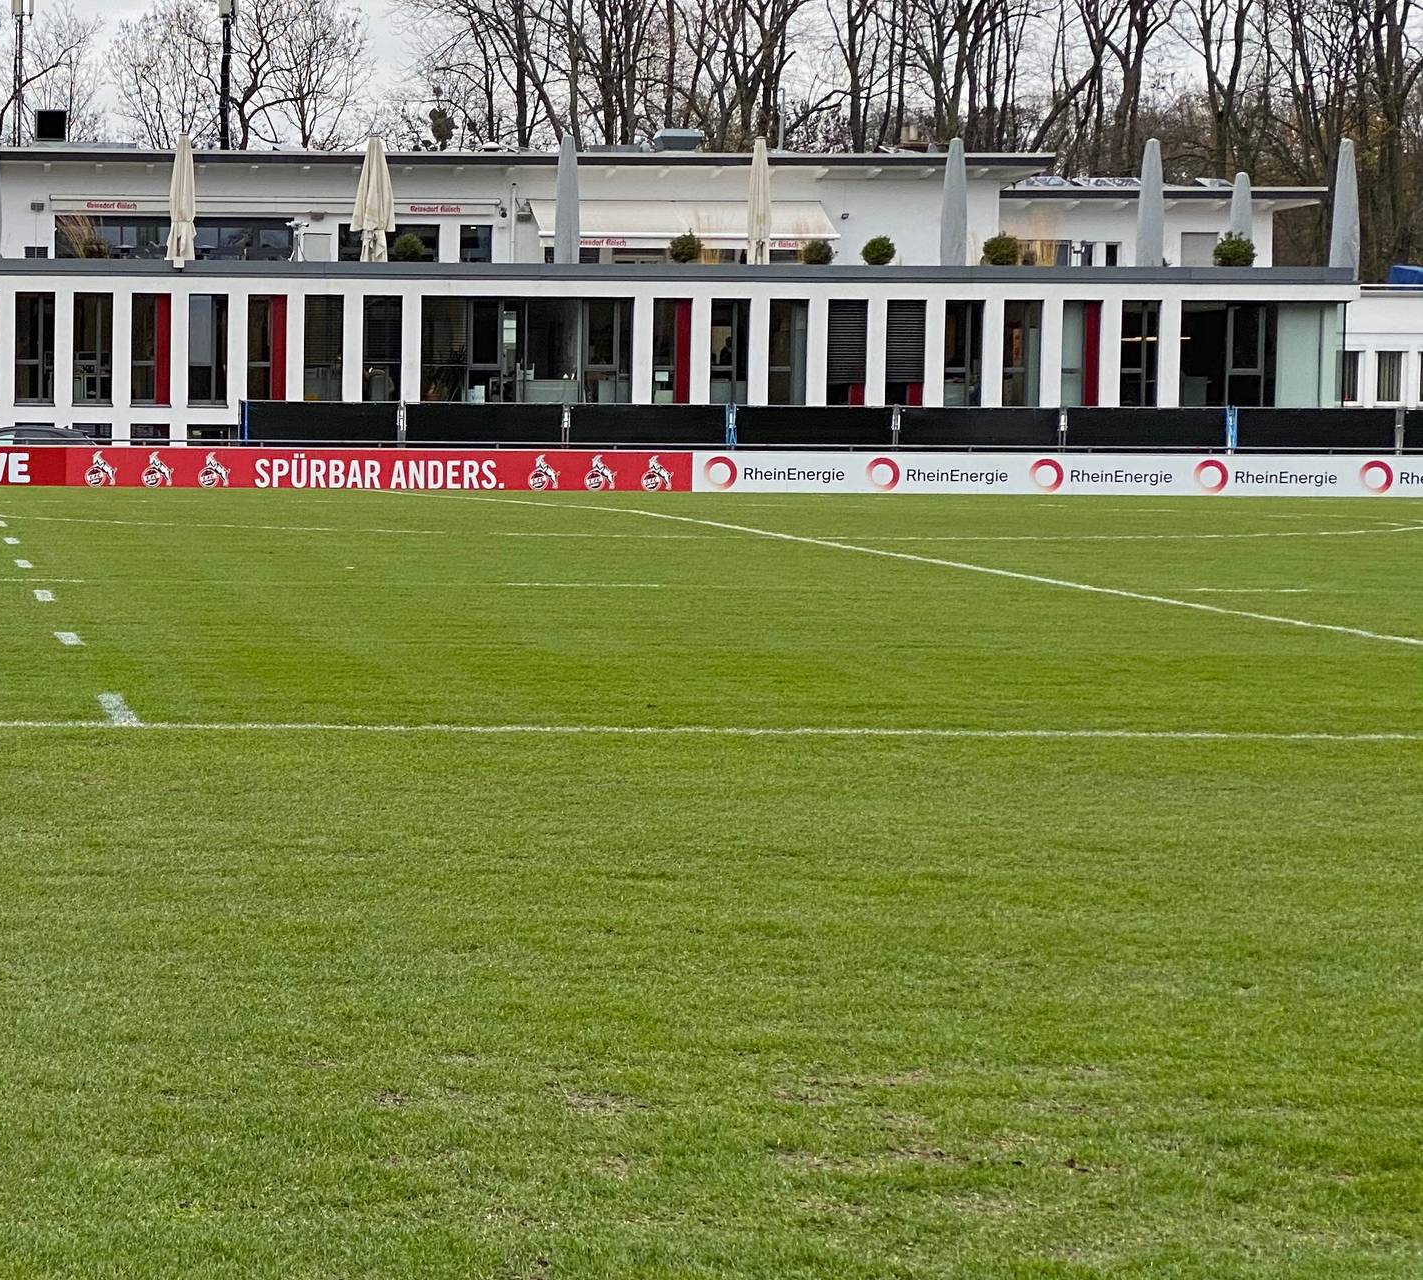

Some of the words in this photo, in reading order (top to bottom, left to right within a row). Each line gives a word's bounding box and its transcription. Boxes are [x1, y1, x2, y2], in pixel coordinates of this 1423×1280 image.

[254, 453, 381, 488] SPÜRBAR
[390, 459, 505, 489] ANDERS.
[743, 467, 845, 484] RheinEnergie
[906, 468, 1009, 485] RheinEnergie
[1070, 469, 1173, 486] RheinEnergie
[1234, 470, 1338, 487] RheinEnergie
